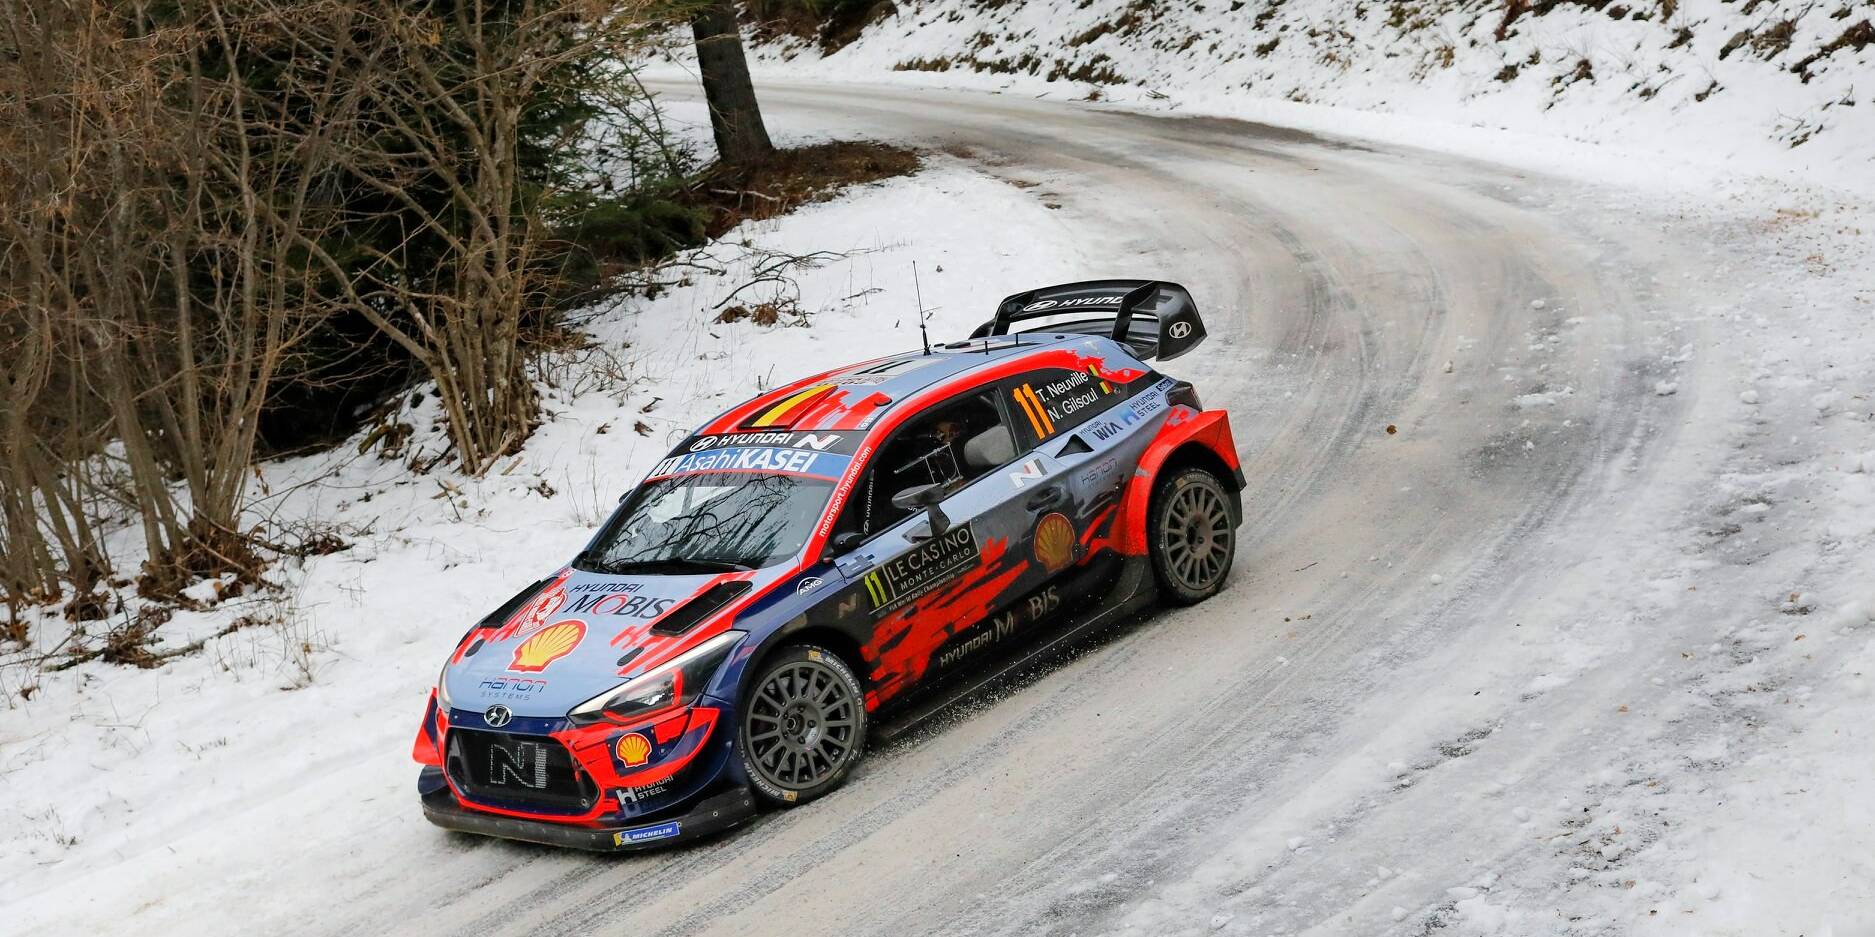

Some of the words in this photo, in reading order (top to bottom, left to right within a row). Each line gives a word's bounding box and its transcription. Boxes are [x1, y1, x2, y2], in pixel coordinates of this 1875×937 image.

[1058, 296, 1124, 307] HYUND
[1035, 389, 1050, 403] T.
[1049, 371, 1089, 399] Neuville
[1013, 382, 1056, 440] 11
[1046, 406, 1063, 422] N.
[1062, 388, 1099, 415] Gilsoul
[1129, 389, 1159, 411] HYUNDAI
[1138, 401, 1161, 417] STEEL
[717, 432, 794, 447] HYUNDAI
[818, 446, 872, 537] motorsport.hyundai.com
[888, 560, 908, 581] LE
[908, 528, 970, 570] CASINO
[570, 583, 646, 593] HYUNDAI
[864, 570, 888, 608] 11
[564, 594, 675, 619] MOBIS
[939, 630, 992, 667] HYUNDAI
[638, 786, 667, 799] STEEL
[632, 827, 673, 839] MICHELIN
